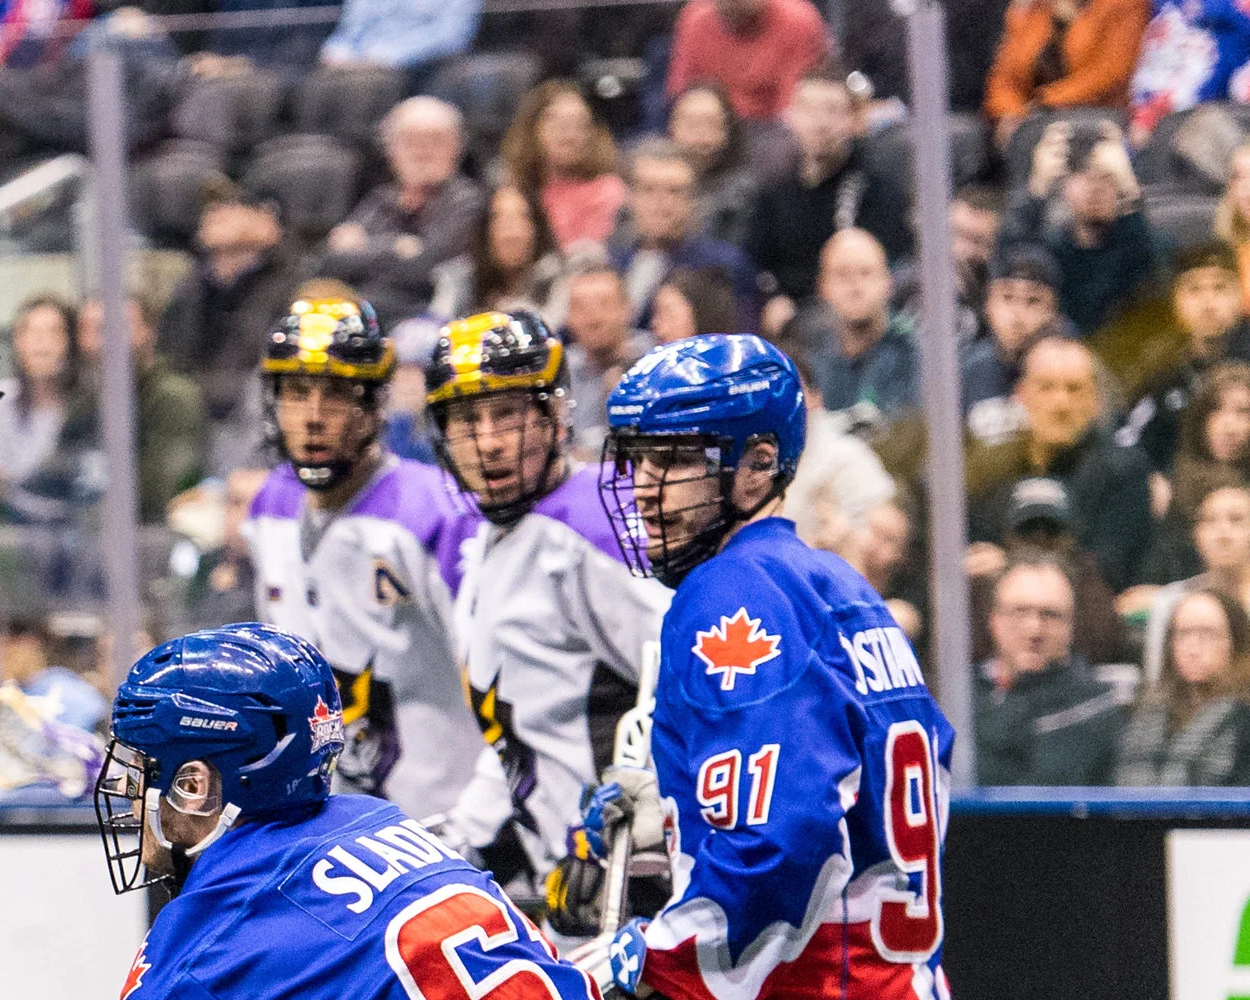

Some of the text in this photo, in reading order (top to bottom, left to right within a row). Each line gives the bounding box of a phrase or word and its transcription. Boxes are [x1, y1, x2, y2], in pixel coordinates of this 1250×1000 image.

[179, 715, 239, 732] BAUER
[696, 744, 781, 831] 91
[871, 720, 945, 963] 9
